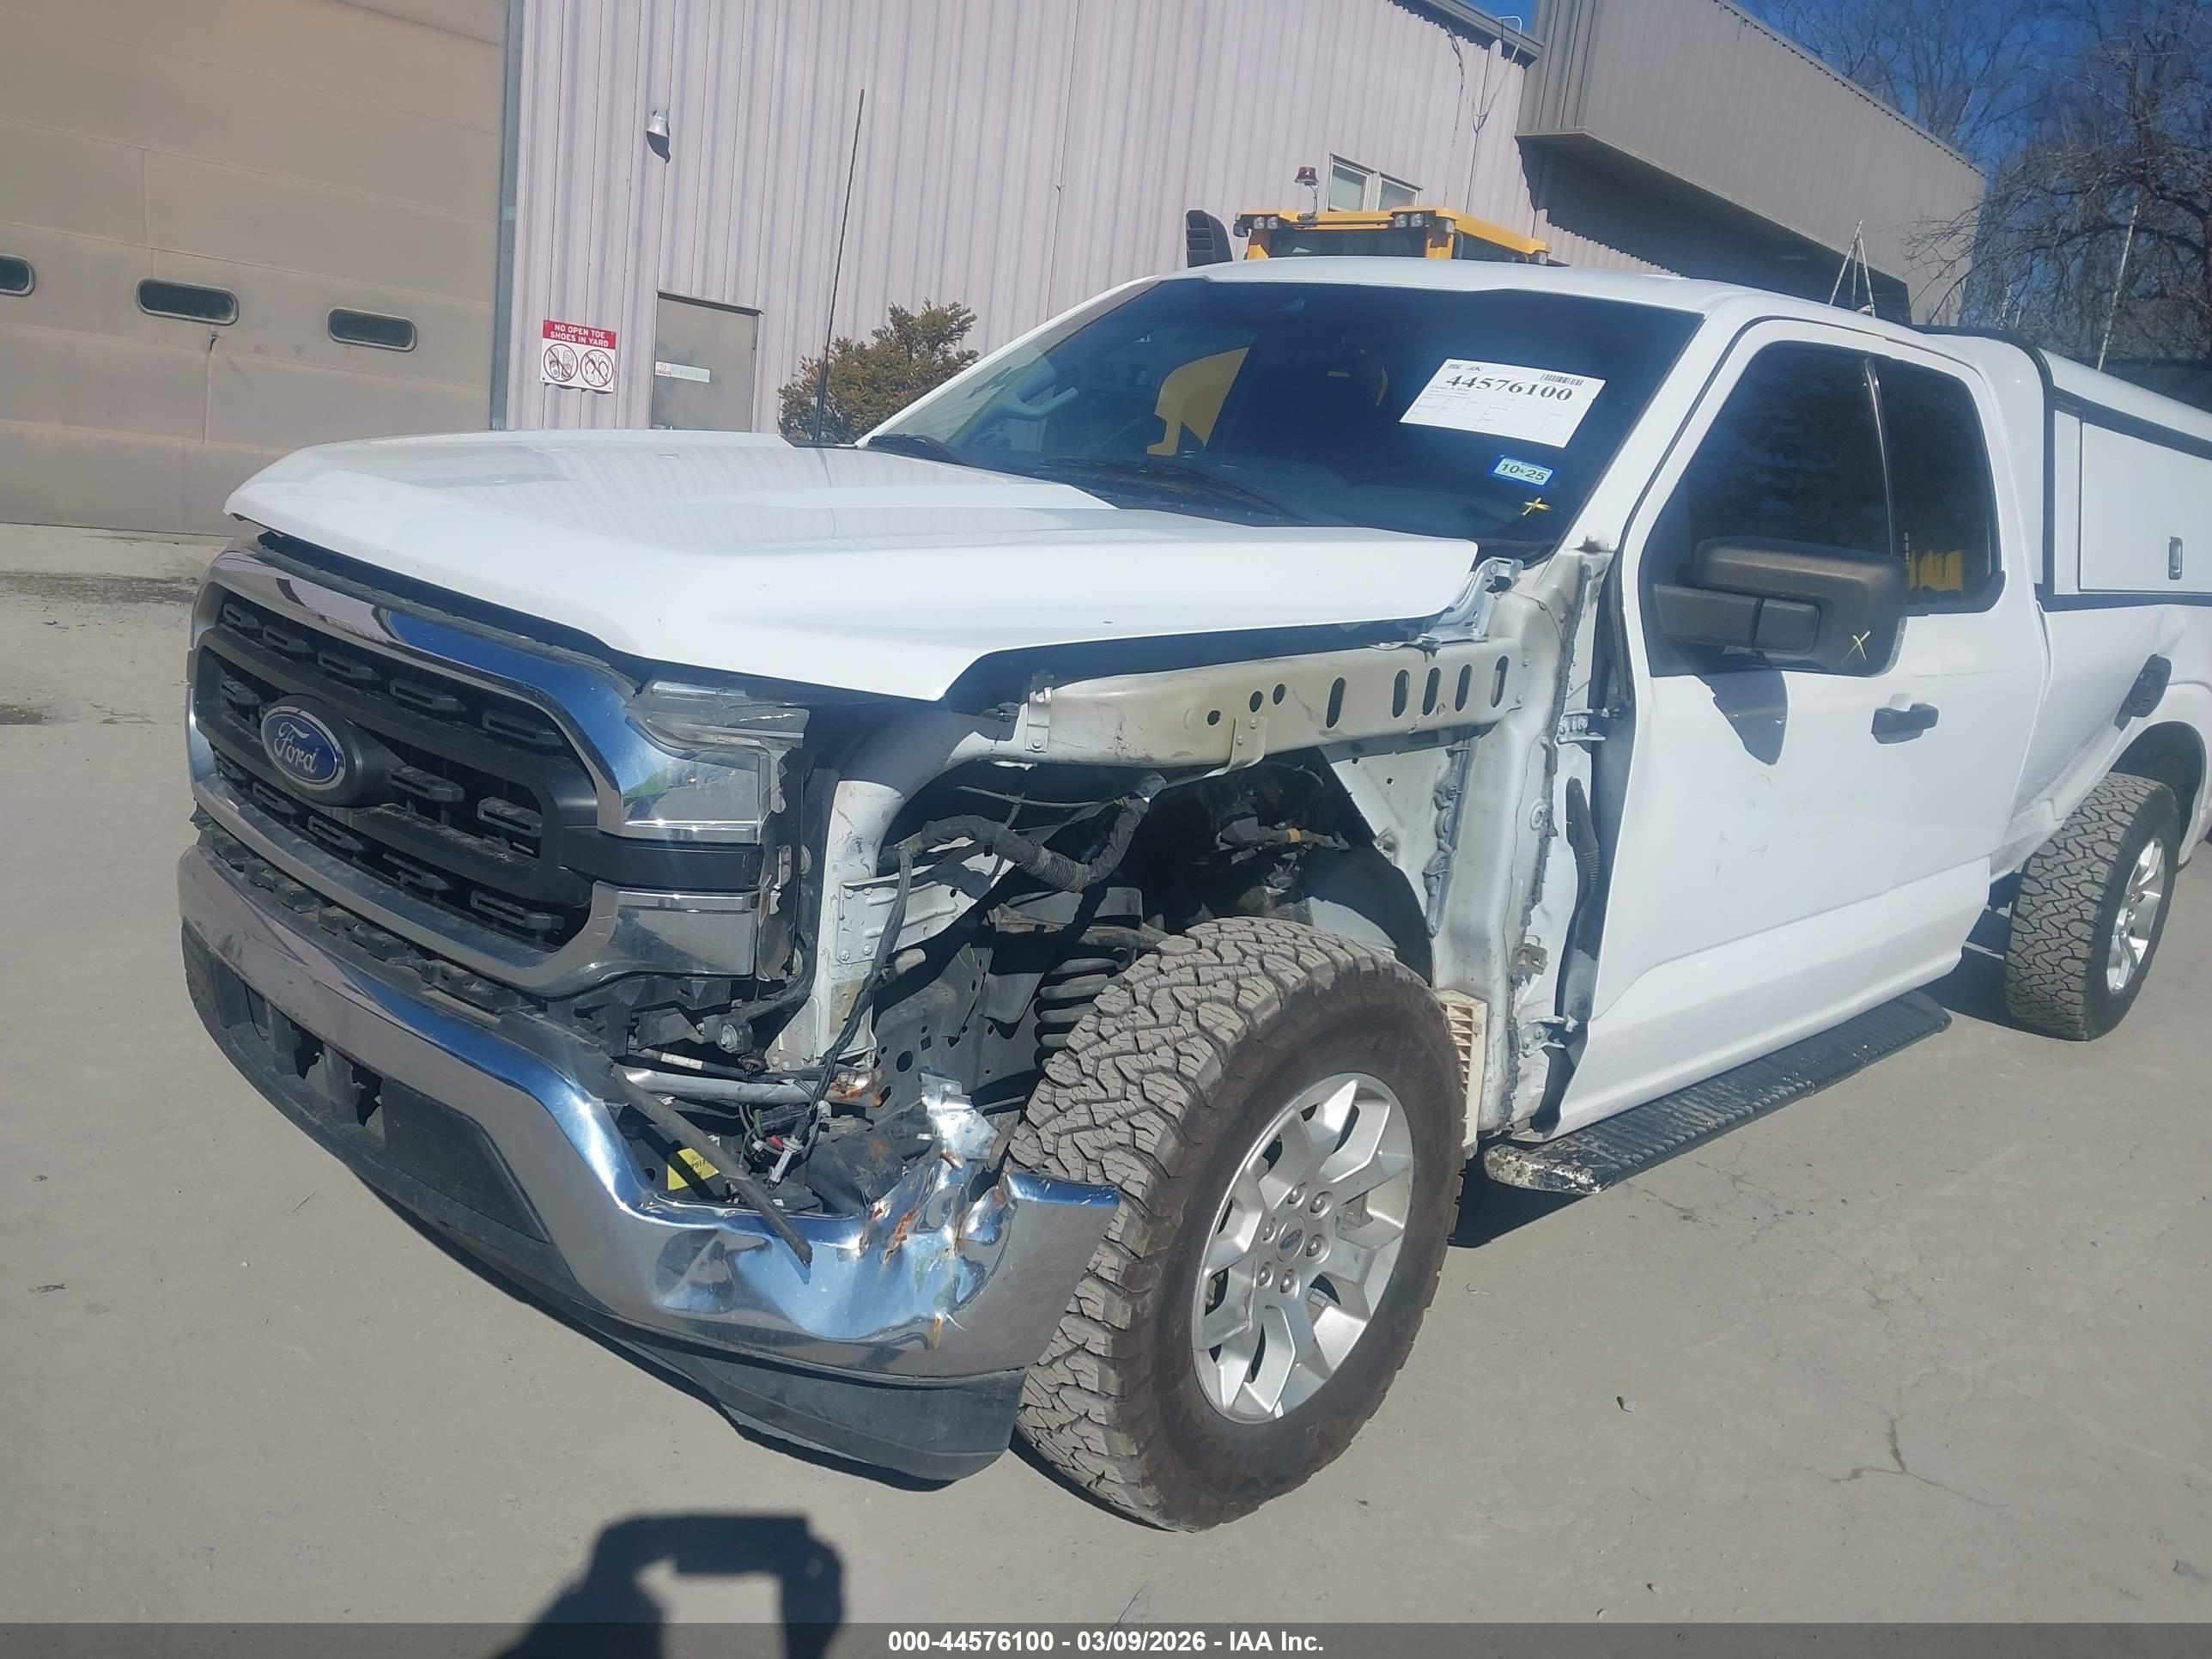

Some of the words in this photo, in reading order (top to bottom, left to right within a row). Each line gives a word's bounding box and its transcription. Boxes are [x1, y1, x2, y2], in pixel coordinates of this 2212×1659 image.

[550, 331, 576, 342] SHOES
[578, 336, 586, 344] IN
[589, 337, 609, 348] YARD
[555, 324, 566, 332] NO
[568, 325, 588, 337] OPEN
[591, 330, 605, 339] TOE
[1446, 374, 1573, 401] 44576100
[274, 721, 319, 774] Ford
